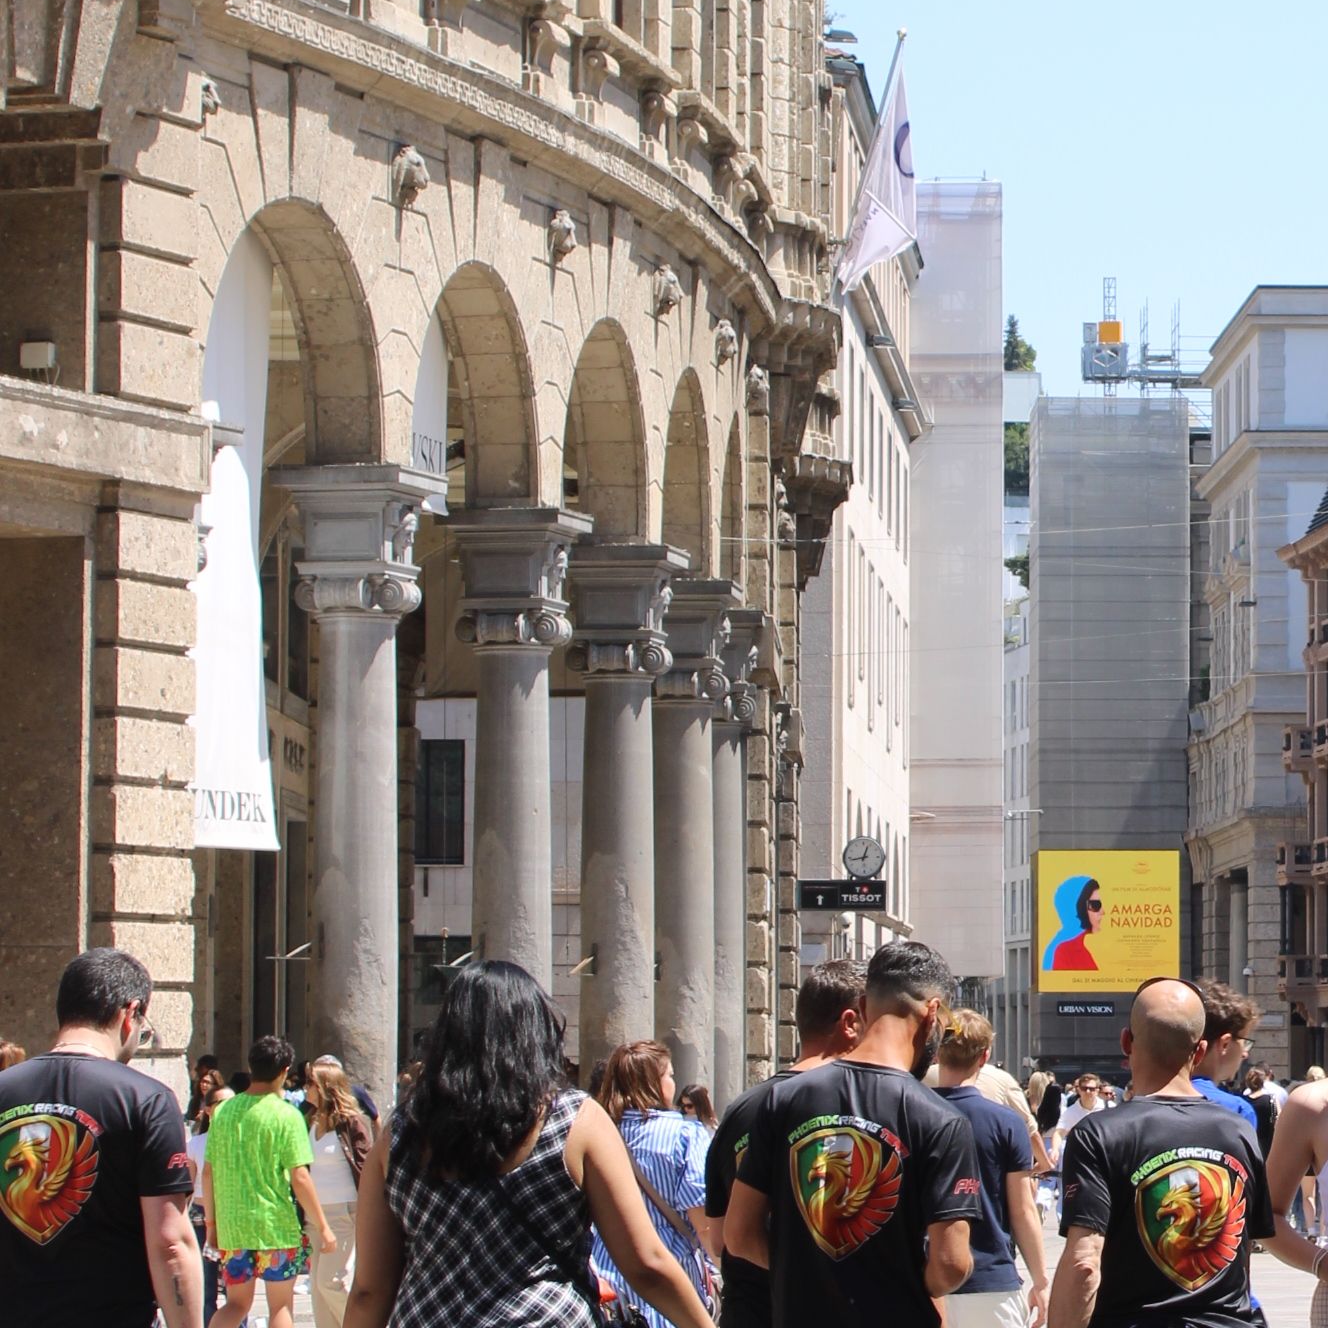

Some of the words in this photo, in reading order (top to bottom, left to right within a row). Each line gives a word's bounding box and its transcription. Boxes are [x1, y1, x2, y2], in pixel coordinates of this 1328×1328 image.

[841, 894, 881, 902] TISSOT
[1110, 903, 1173, 915] AMARGA
[1110, 916, 1173, 928] NAVIDAD
[1058, 1005, 1085, 1014] URBAN
[1086, 1005, 1113, 1014] VISION
[34, 1102, 78, 1117] RACING
[787, 1114, 840, 1144] PHOENIX
[839, 1115, 883, 1134] RACING
[1130, 1148, 1179, 1186] PHOENIX
[1177, 1146, 1225, 1162] RACING
[1223, 1153, 1249, 1183] TEAM
